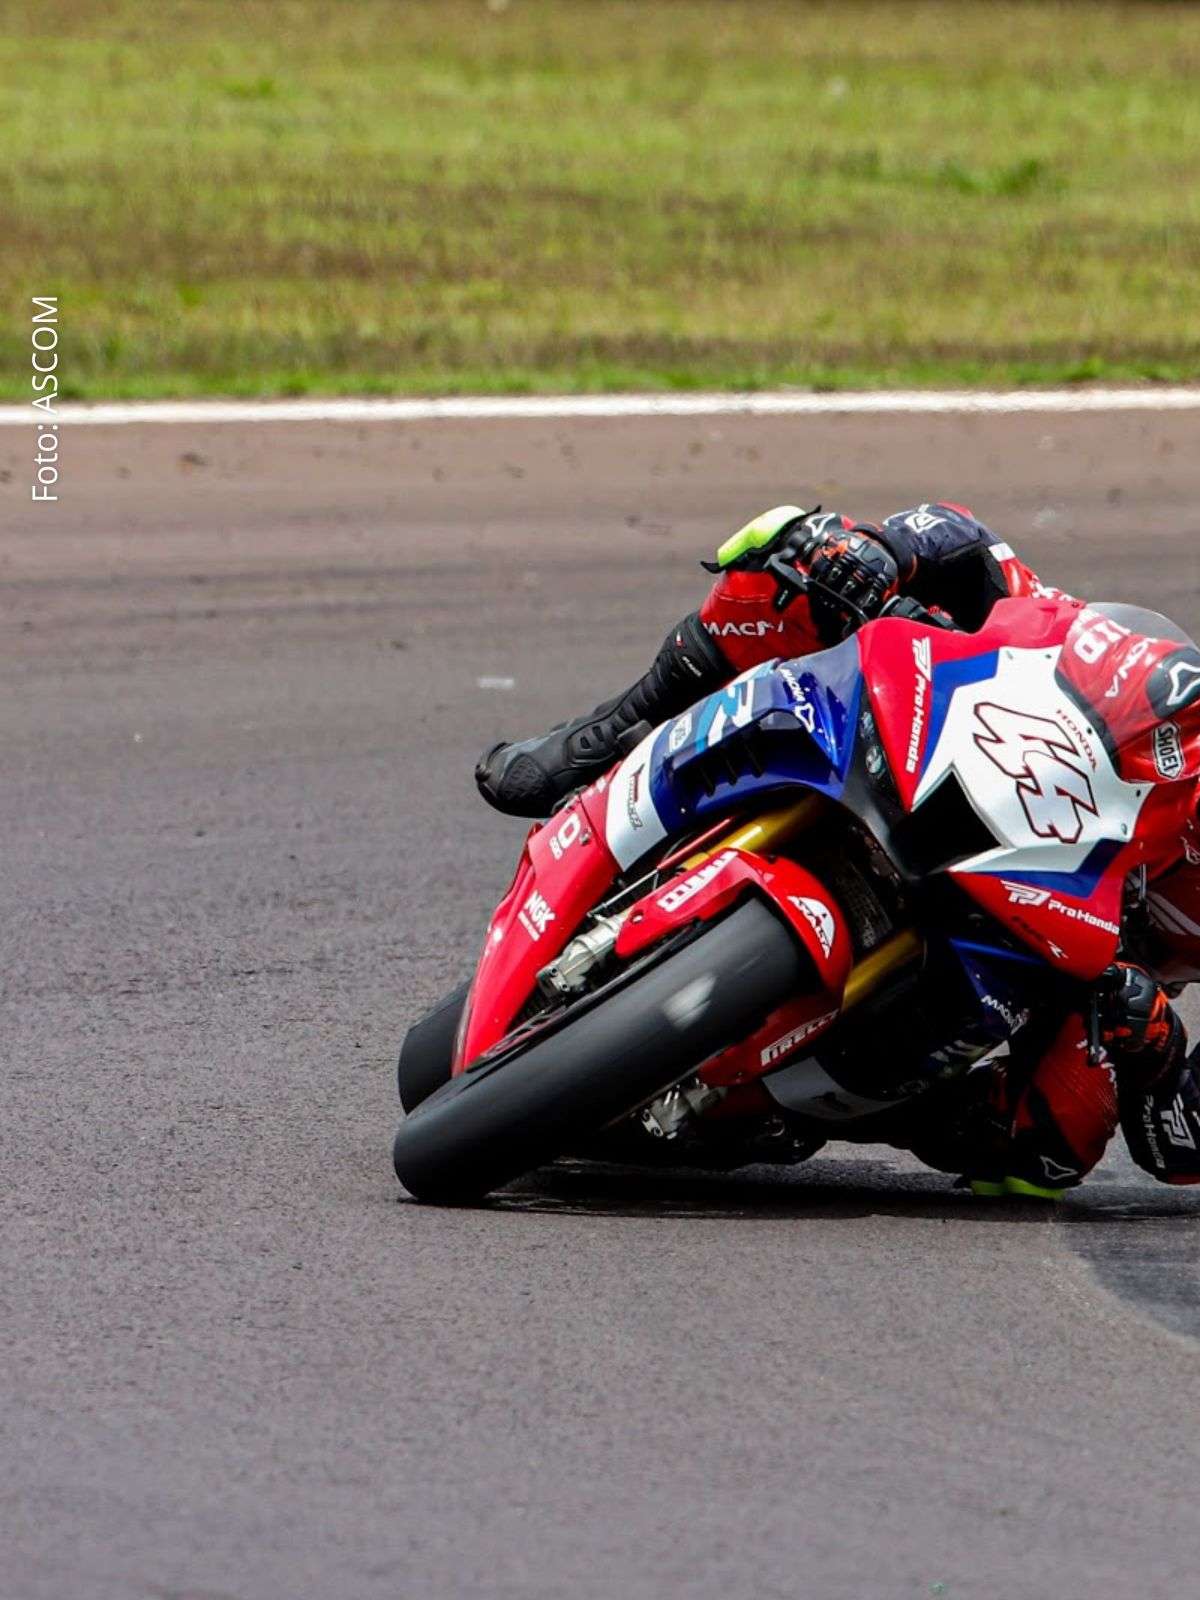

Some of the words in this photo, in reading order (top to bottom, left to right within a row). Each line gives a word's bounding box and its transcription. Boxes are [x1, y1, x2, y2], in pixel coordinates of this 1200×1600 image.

[1056, 709, 1098, 773] HONDA
[1157, 725, 1180, 773] SHOEI
[523, 889, 556, 933] NGK
